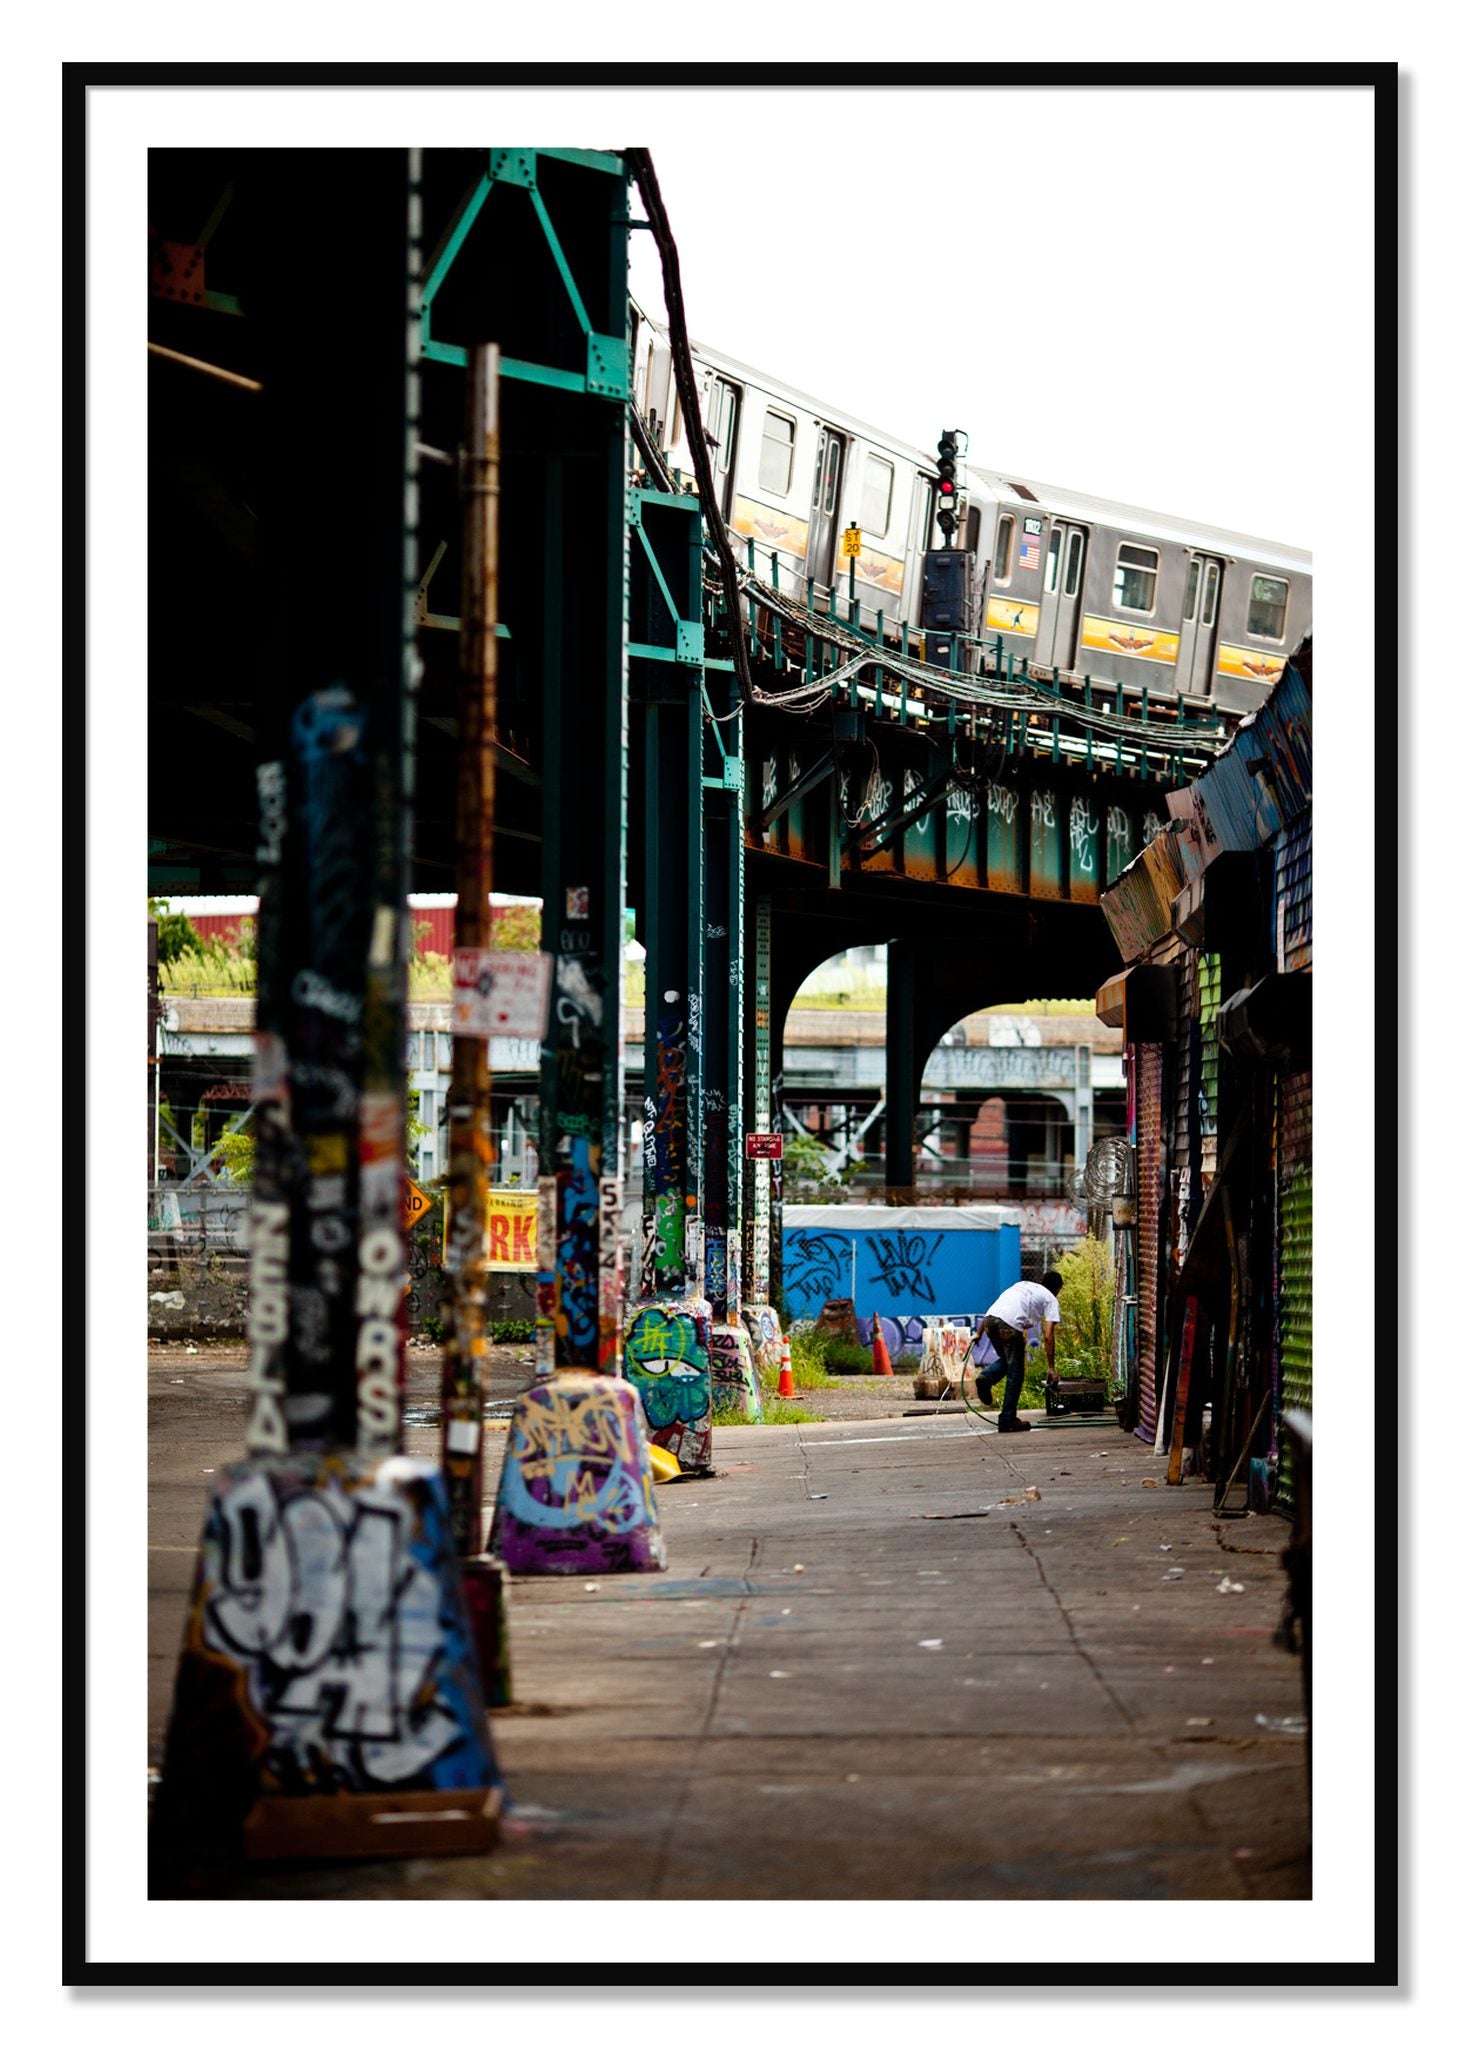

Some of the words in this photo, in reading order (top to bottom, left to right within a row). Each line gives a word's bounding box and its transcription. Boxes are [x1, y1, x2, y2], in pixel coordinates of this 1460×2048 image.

[846, 543, 860, 552] 20
[403, 1197, 423, 1211] ND
[487, 1198, 523, 1208] ARKING
[489, 1215, 535, 1262] RK
